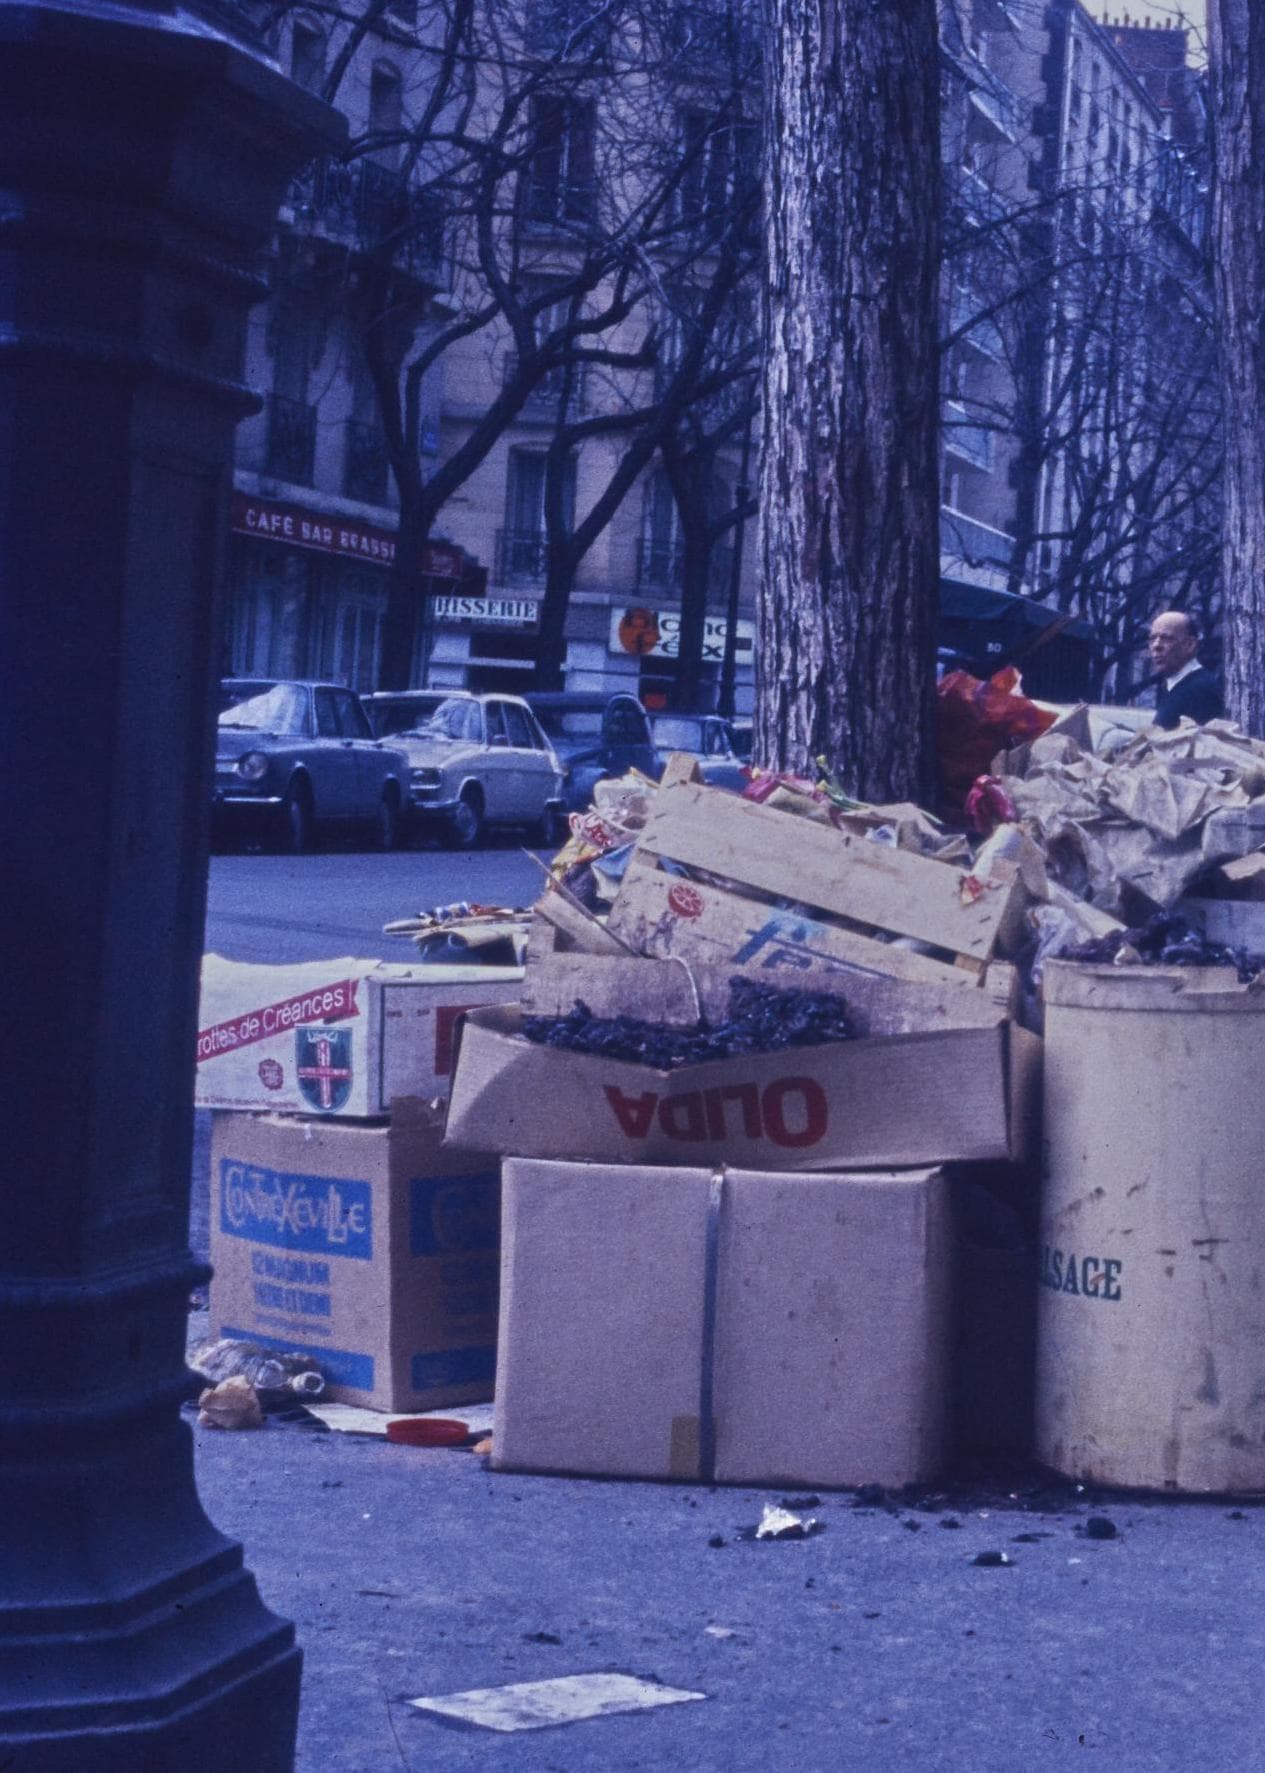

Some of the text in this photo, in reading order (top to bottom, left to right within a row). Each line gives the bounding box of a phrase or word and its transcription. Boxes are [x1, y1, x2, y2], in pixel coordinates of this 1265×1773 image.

[301, 521, 332, 546] BAR
[239, 1015, 260, 1040] de
[263, 987, 345, 1032] Créances
[602, 1075, 829, 1149] OLIDA
